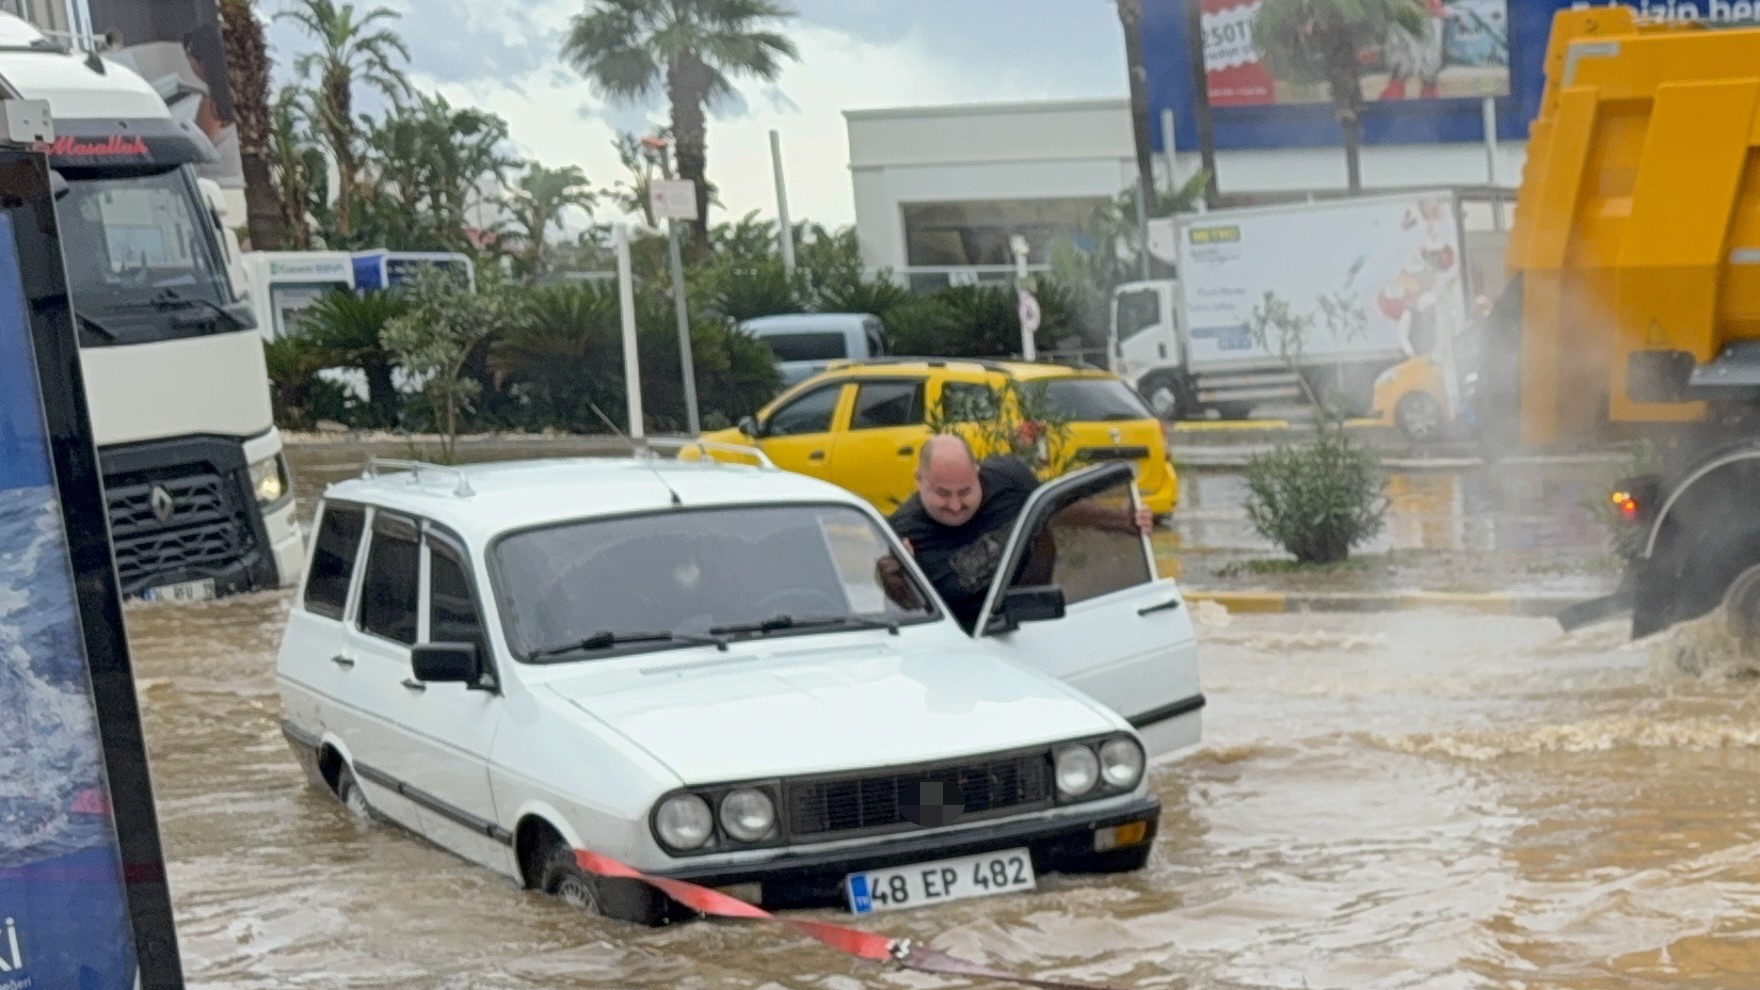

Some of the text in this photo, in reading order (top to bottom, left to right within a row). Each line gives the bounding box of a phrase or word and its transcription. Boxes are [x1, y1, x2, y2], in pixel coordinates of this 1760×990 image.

[871, 874, 909, 905] 48
[921, 867, 958, 899] EP
[972, 856, 1028, 890] 482
